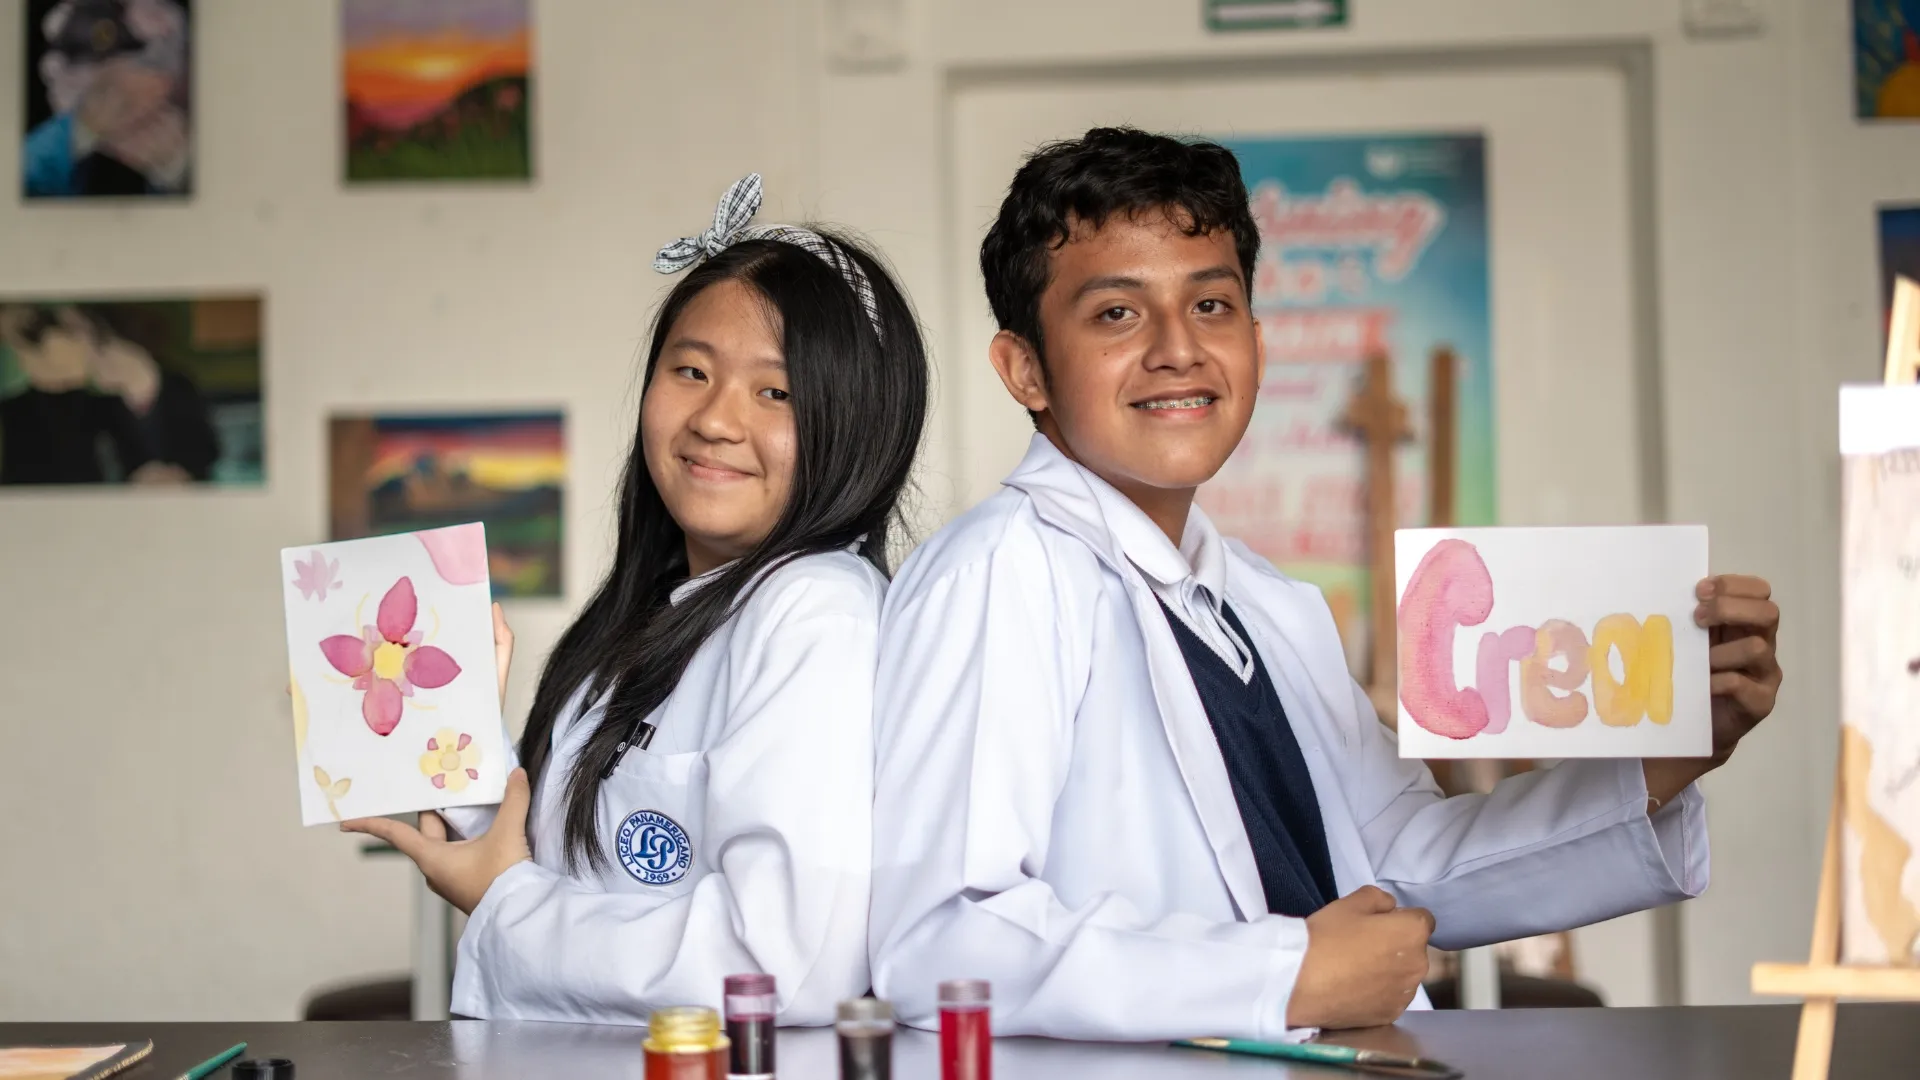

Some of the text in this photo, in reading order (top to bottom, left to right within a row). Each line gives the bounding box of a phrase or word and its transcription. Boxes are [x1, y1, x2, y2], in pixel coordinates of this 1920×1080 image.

[620, 812, 690, 869] LICEO PANAMERICANO
[643, 870, 670, 882] 1969
